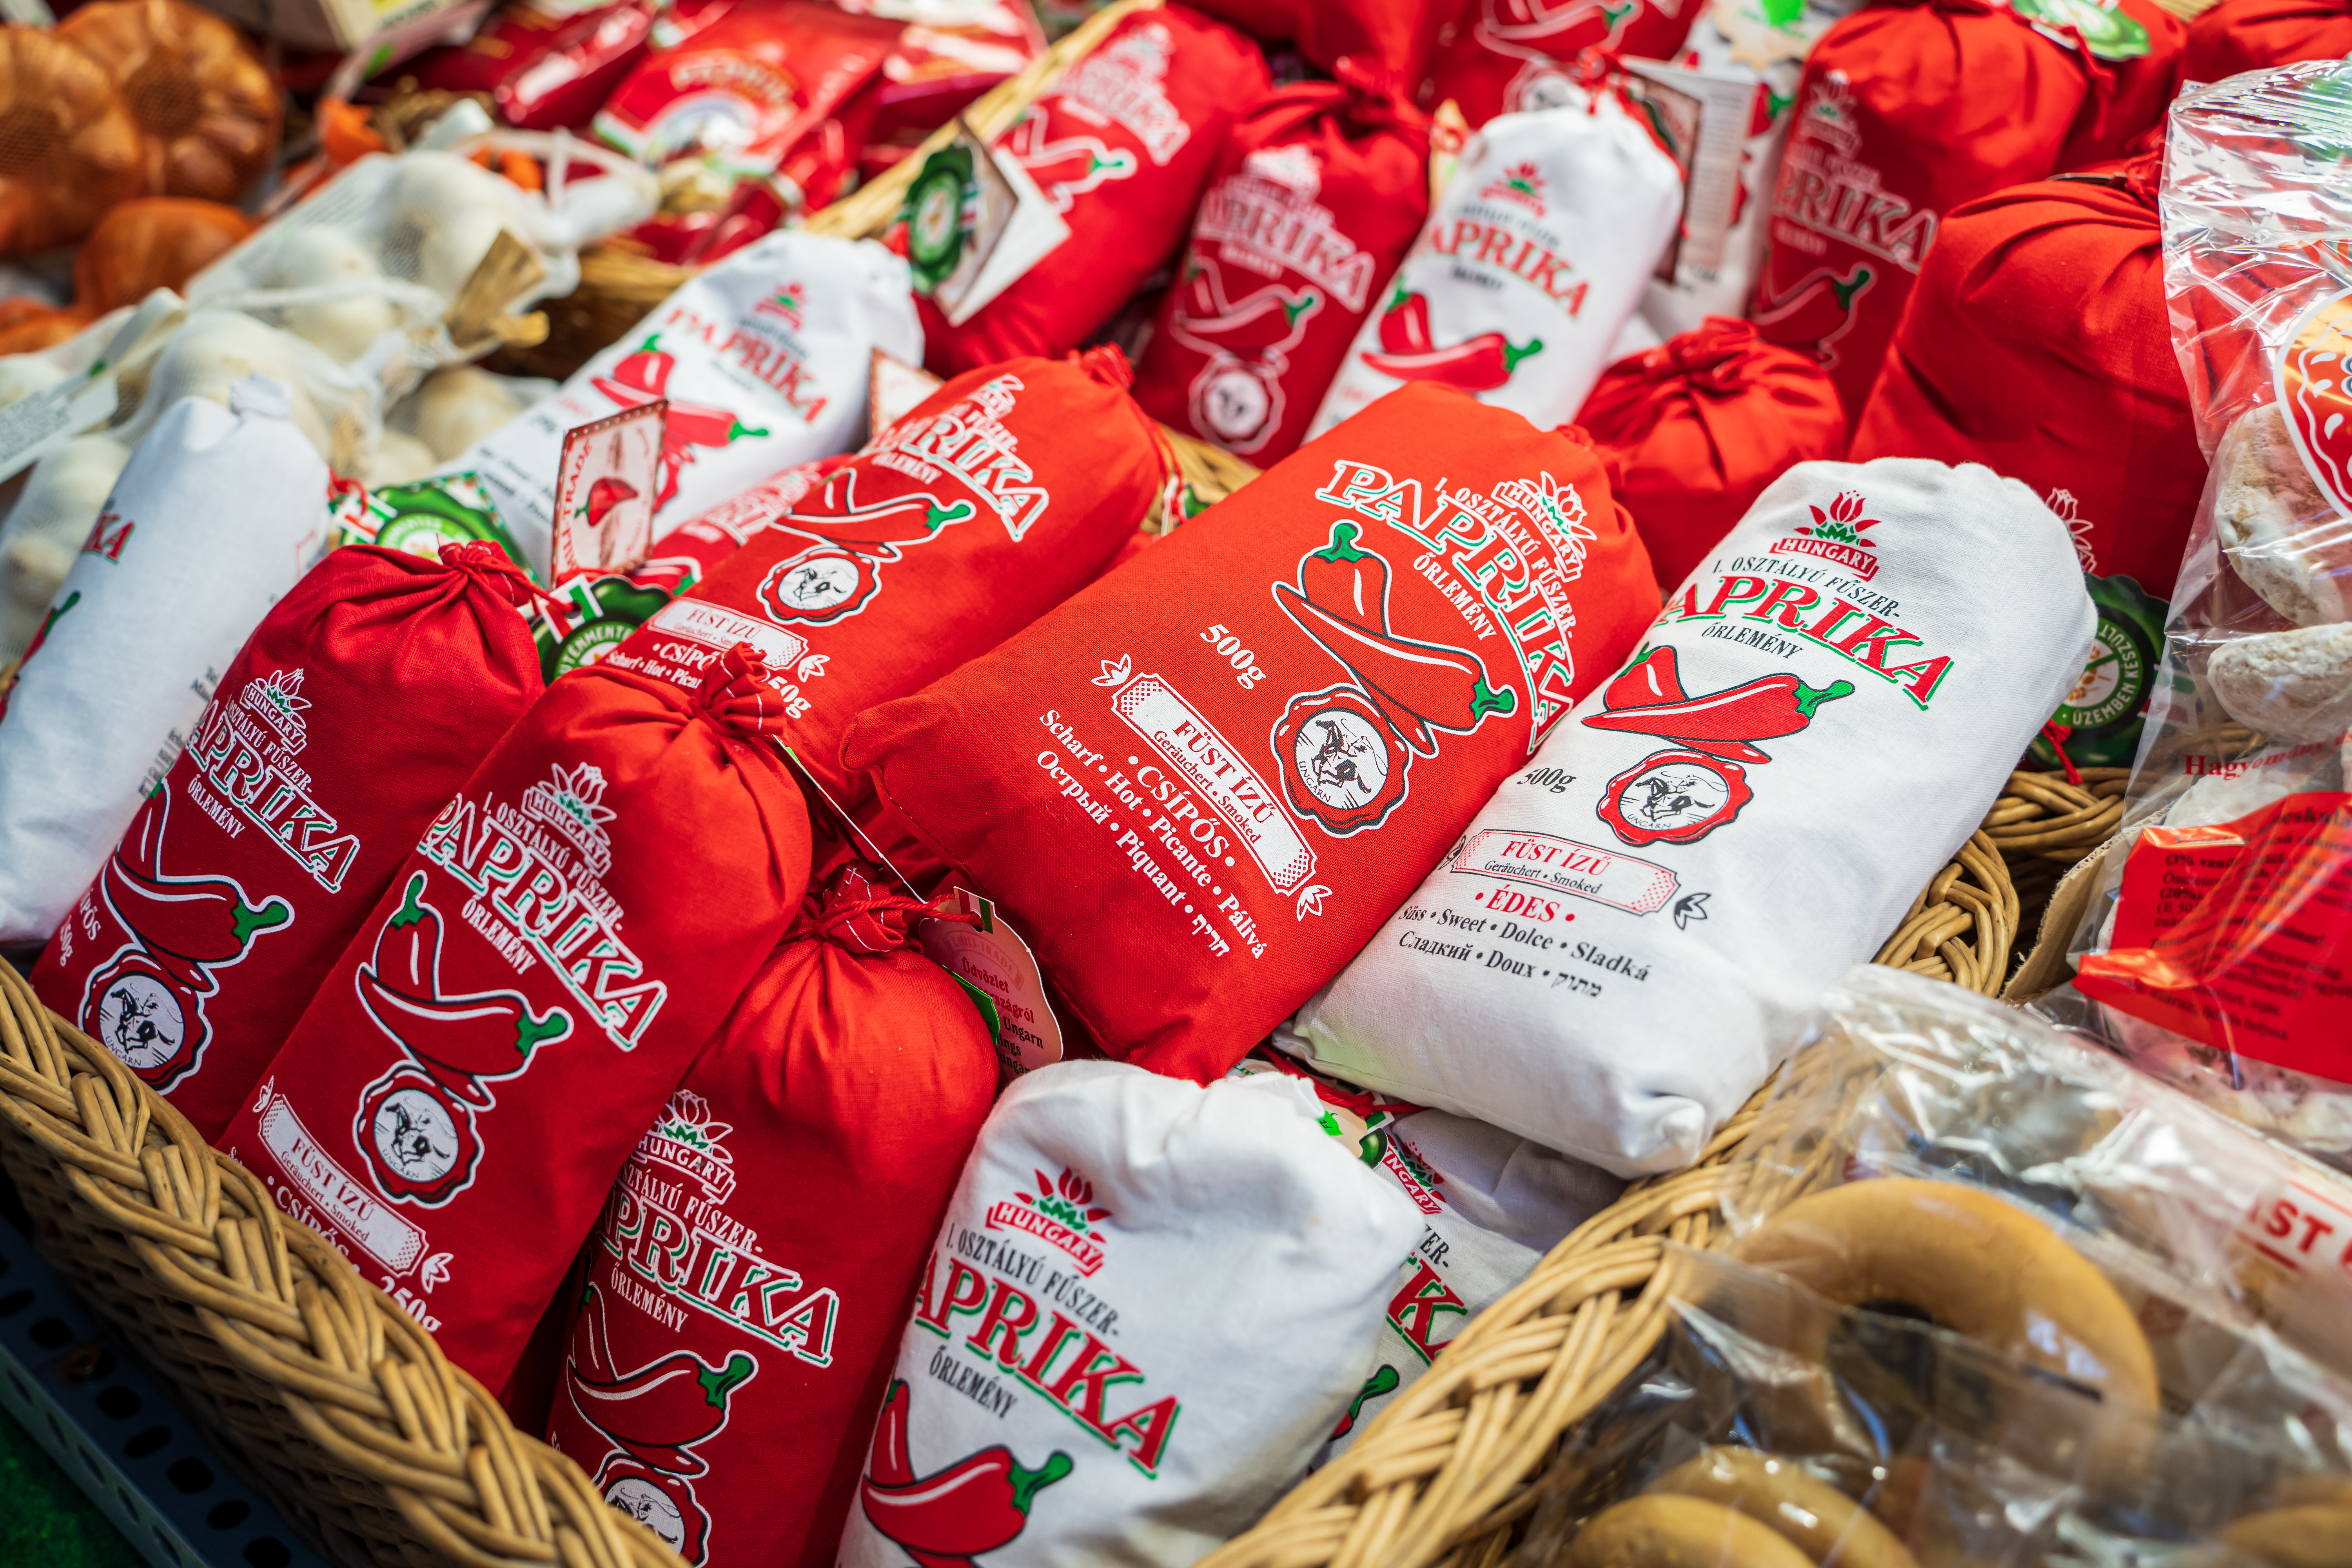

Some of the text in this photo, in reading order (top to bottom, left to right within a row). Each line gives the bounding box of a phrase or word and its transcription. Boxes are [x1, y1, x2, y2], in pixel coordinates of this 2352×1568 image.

[1433, 477, 1577, 639] I. OSZTÁLYÚ FŰSZER-
[1510, 486, 1581, 573] HUNGARY
[1782, 538, 1873, 571] HUNGARY
[1315, 459, 1575, 756] PAPRIKA
[1413, 552, 1497, 641] ŐRLEMÉNY
[1731, 556, 1827, 584] OSZTÁLYÚ
[1826, 575, 1900, 618] FŰSZER-
[1200, 623, 1267, 690] 500g
[1701, 624, 1804, 660] ŐRLEMÉNY
[247, 687, 302, 741] HUNGARY
[2073, 682, 2136, 725] ÜZEMBEN
[263, 742, 312, 793] FŰSZER-
[1037, 750, 1113, 826] Острый
[1153, 730, 1259, 844] Geräuchert Smoked
[1172, 719, 1275, 824] FÜST ÍZŰ
[1298, 760, 1331, 803] UNGARN
[1516, 767, 1578, 794] 500g
[187, 773, 246, 840] ŐRLEMÉNY
[534, 791, 606, 865] HUNGARY
[1039, 709, 1266, 960] Scharf Hot Picante Pálivá
[1136, 765, 1229, 860] CSÍPŐS
[1627, 813, 1672, 829] UNGARN
[496, 802, 572, 870] OSZTÁLYÚ
[567, 860, 624, 931] FŰSZER-
[1116, 828, 1186, 907] Piquant
[1484, 860, 1603, 895] Geräuchert Smoked
[1500, 838, 1614, 877] FÜST ÍZŰ
[461, 893, 537, 975] ŐRLEMÉNY
[1485, 884, 1562, 923] ÉDES
[952, 935, 1014, 973] CHILI-TRADE
[961, 956, 1009, 994] Üdvözlet
[1398, 930, 1473, 962] Сладкий
[1437, 908, 1488, 934] Sweet
[1497, 920, 1555, 951] Dolce
[1570, 941, 1653, 982] Sladká
[1484, 949, 1537, 980] Doux
[971, 983, 1035, 1024] rszágról
[1002, 1015, 1044, 1049] Ungarn
[291, 1136, 338, 1191] FÜST
[335, 1180, 376, 1222] ÍZŰ
[639, 1135, 727, 1185] HUNGARY
[280, 1150, 326, 1205] Geräuchert
[330, 1202, 370, 1243] Smoked
[683, 1195, 764, 1253] FŰSZER-
[998, 1201, 1103, 1271] HUNGARY
[610, 1259, 688, 1333] ŐRLEMÉNY
[958, 1229, 1046, 1286] OSZTÁLYÚ
[1043, 1270, 1120, 1337] FŰSZER-
[929, 1346, 1018, 1419] ŐRLEMÉNY
